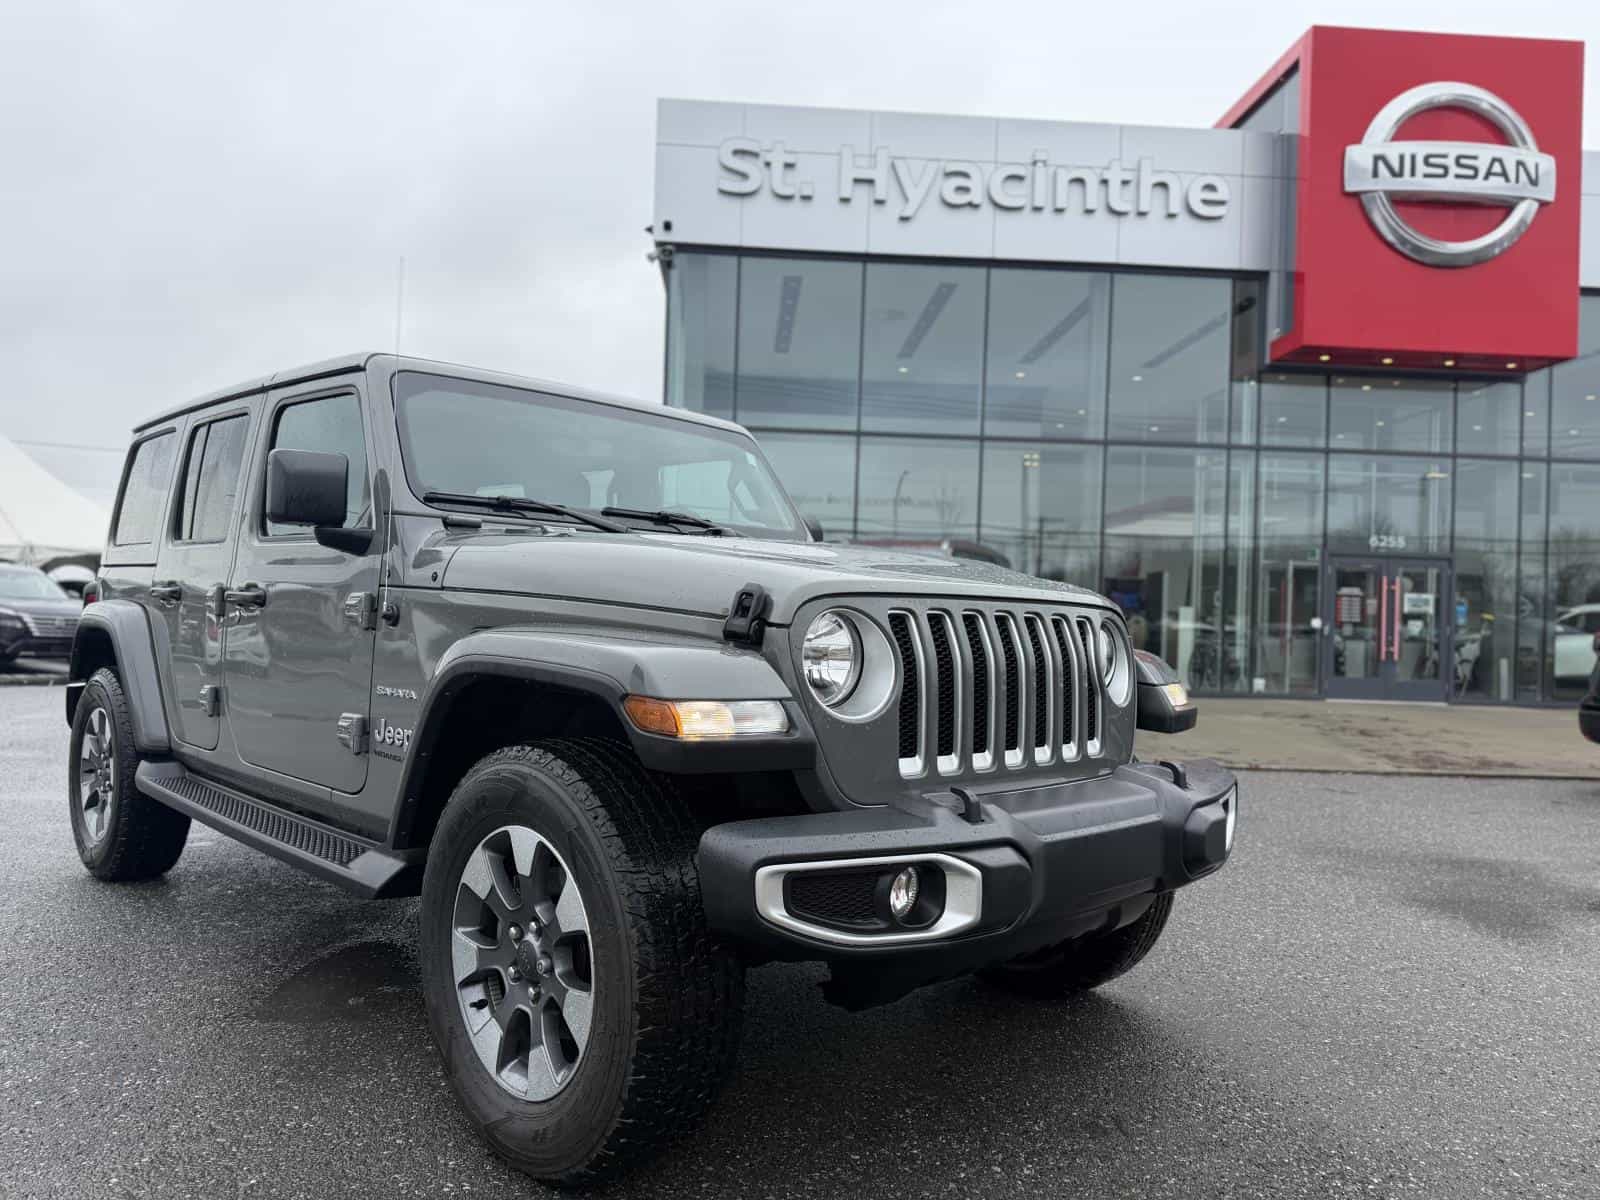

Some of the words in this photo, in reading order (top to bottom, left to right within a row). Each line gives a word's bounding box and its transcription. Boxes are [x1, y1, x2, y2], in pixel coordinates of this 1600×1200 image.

[717, 136, 815, 198] St.
[838, 143, 1230, 223] Hyacinthe
[1372, 153, 1540, 188] NISSAN
